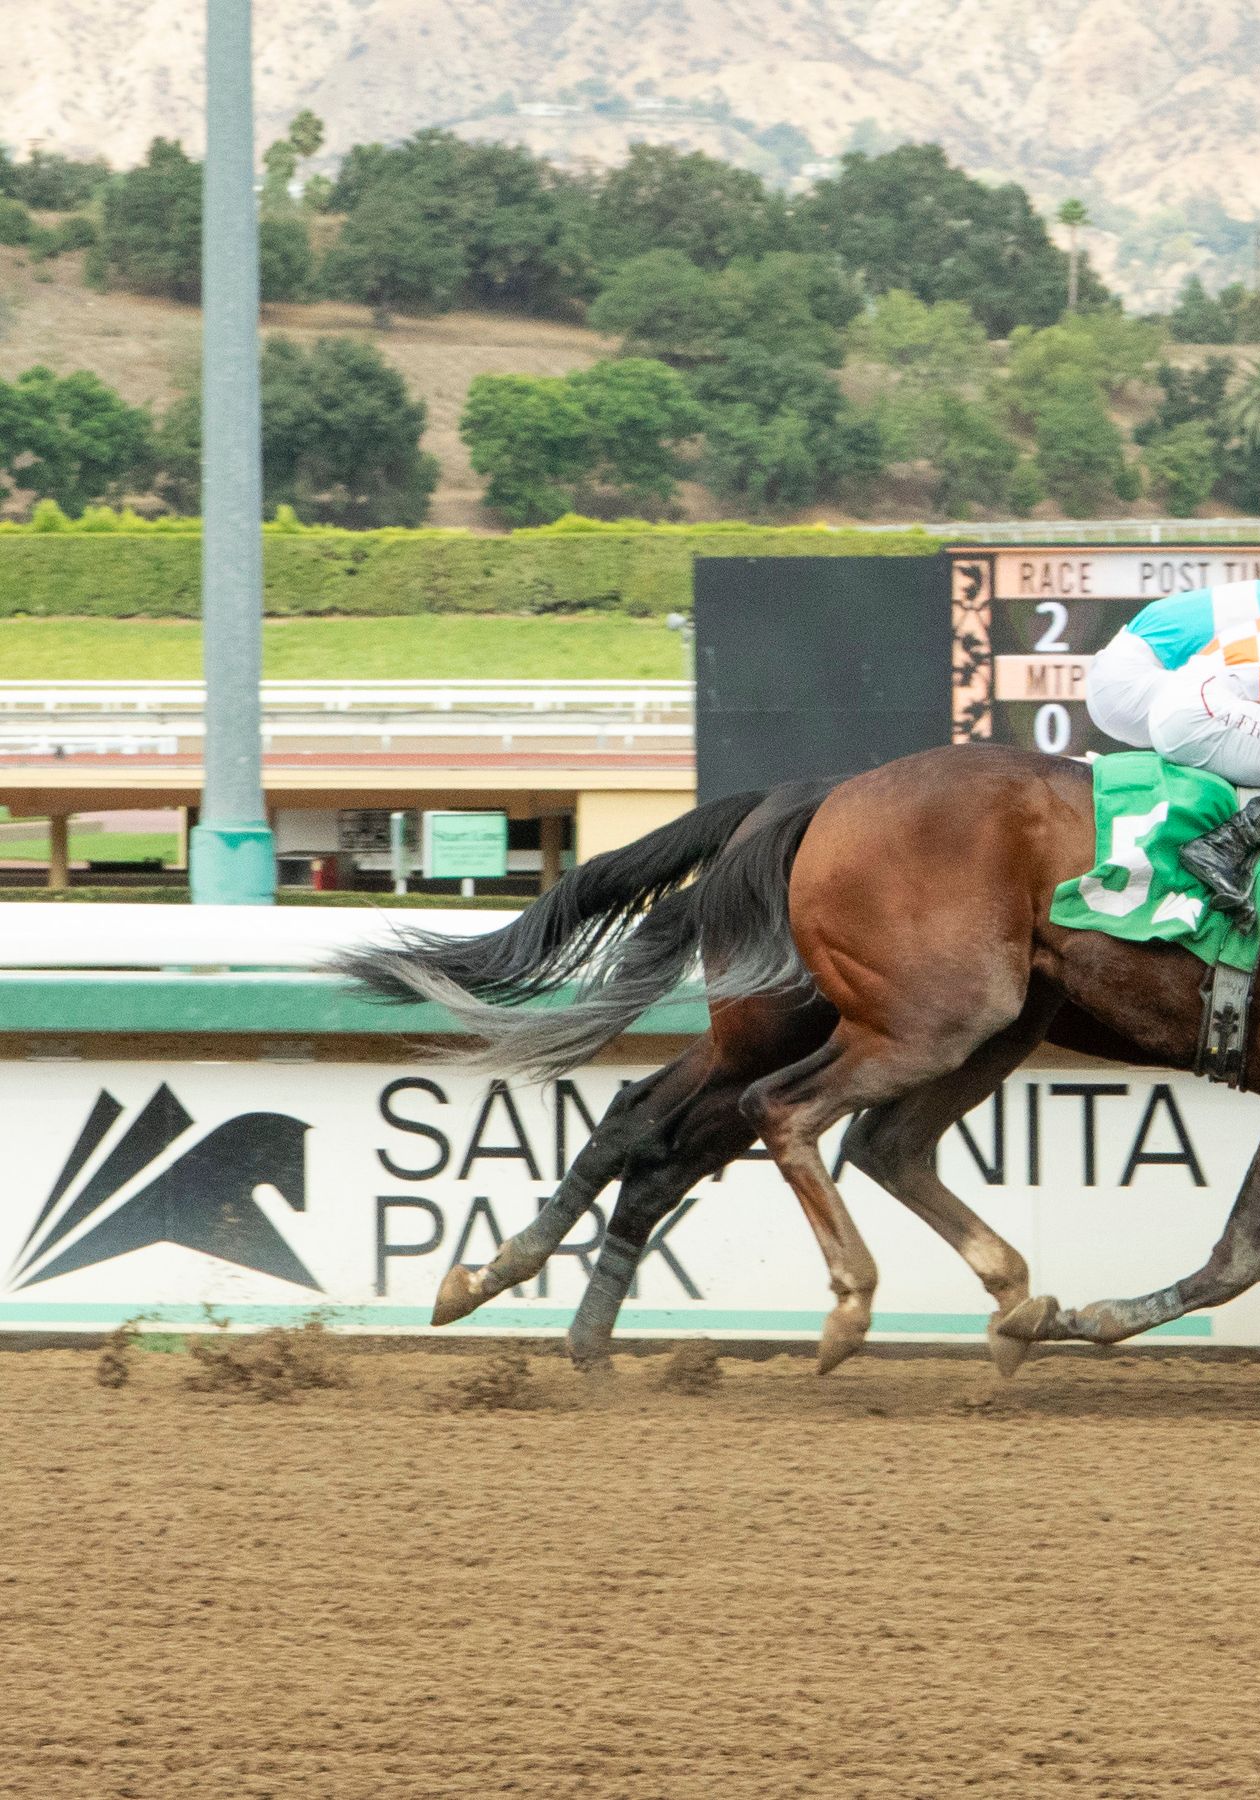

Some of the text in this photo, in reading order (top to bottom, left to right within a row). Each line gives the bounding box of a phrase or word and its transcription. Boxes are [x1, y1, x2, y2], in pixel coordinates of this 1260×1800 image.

[1020, 562, 1092, 594] RACE
[1139, 562, 1209, 594] POST
[1034, 601, 1070, 652] 2
[1026, 664, 1085, 697] MTP
[1034, 704, 1071, 755] 0
[1078, 801, 1169, 918] 5
